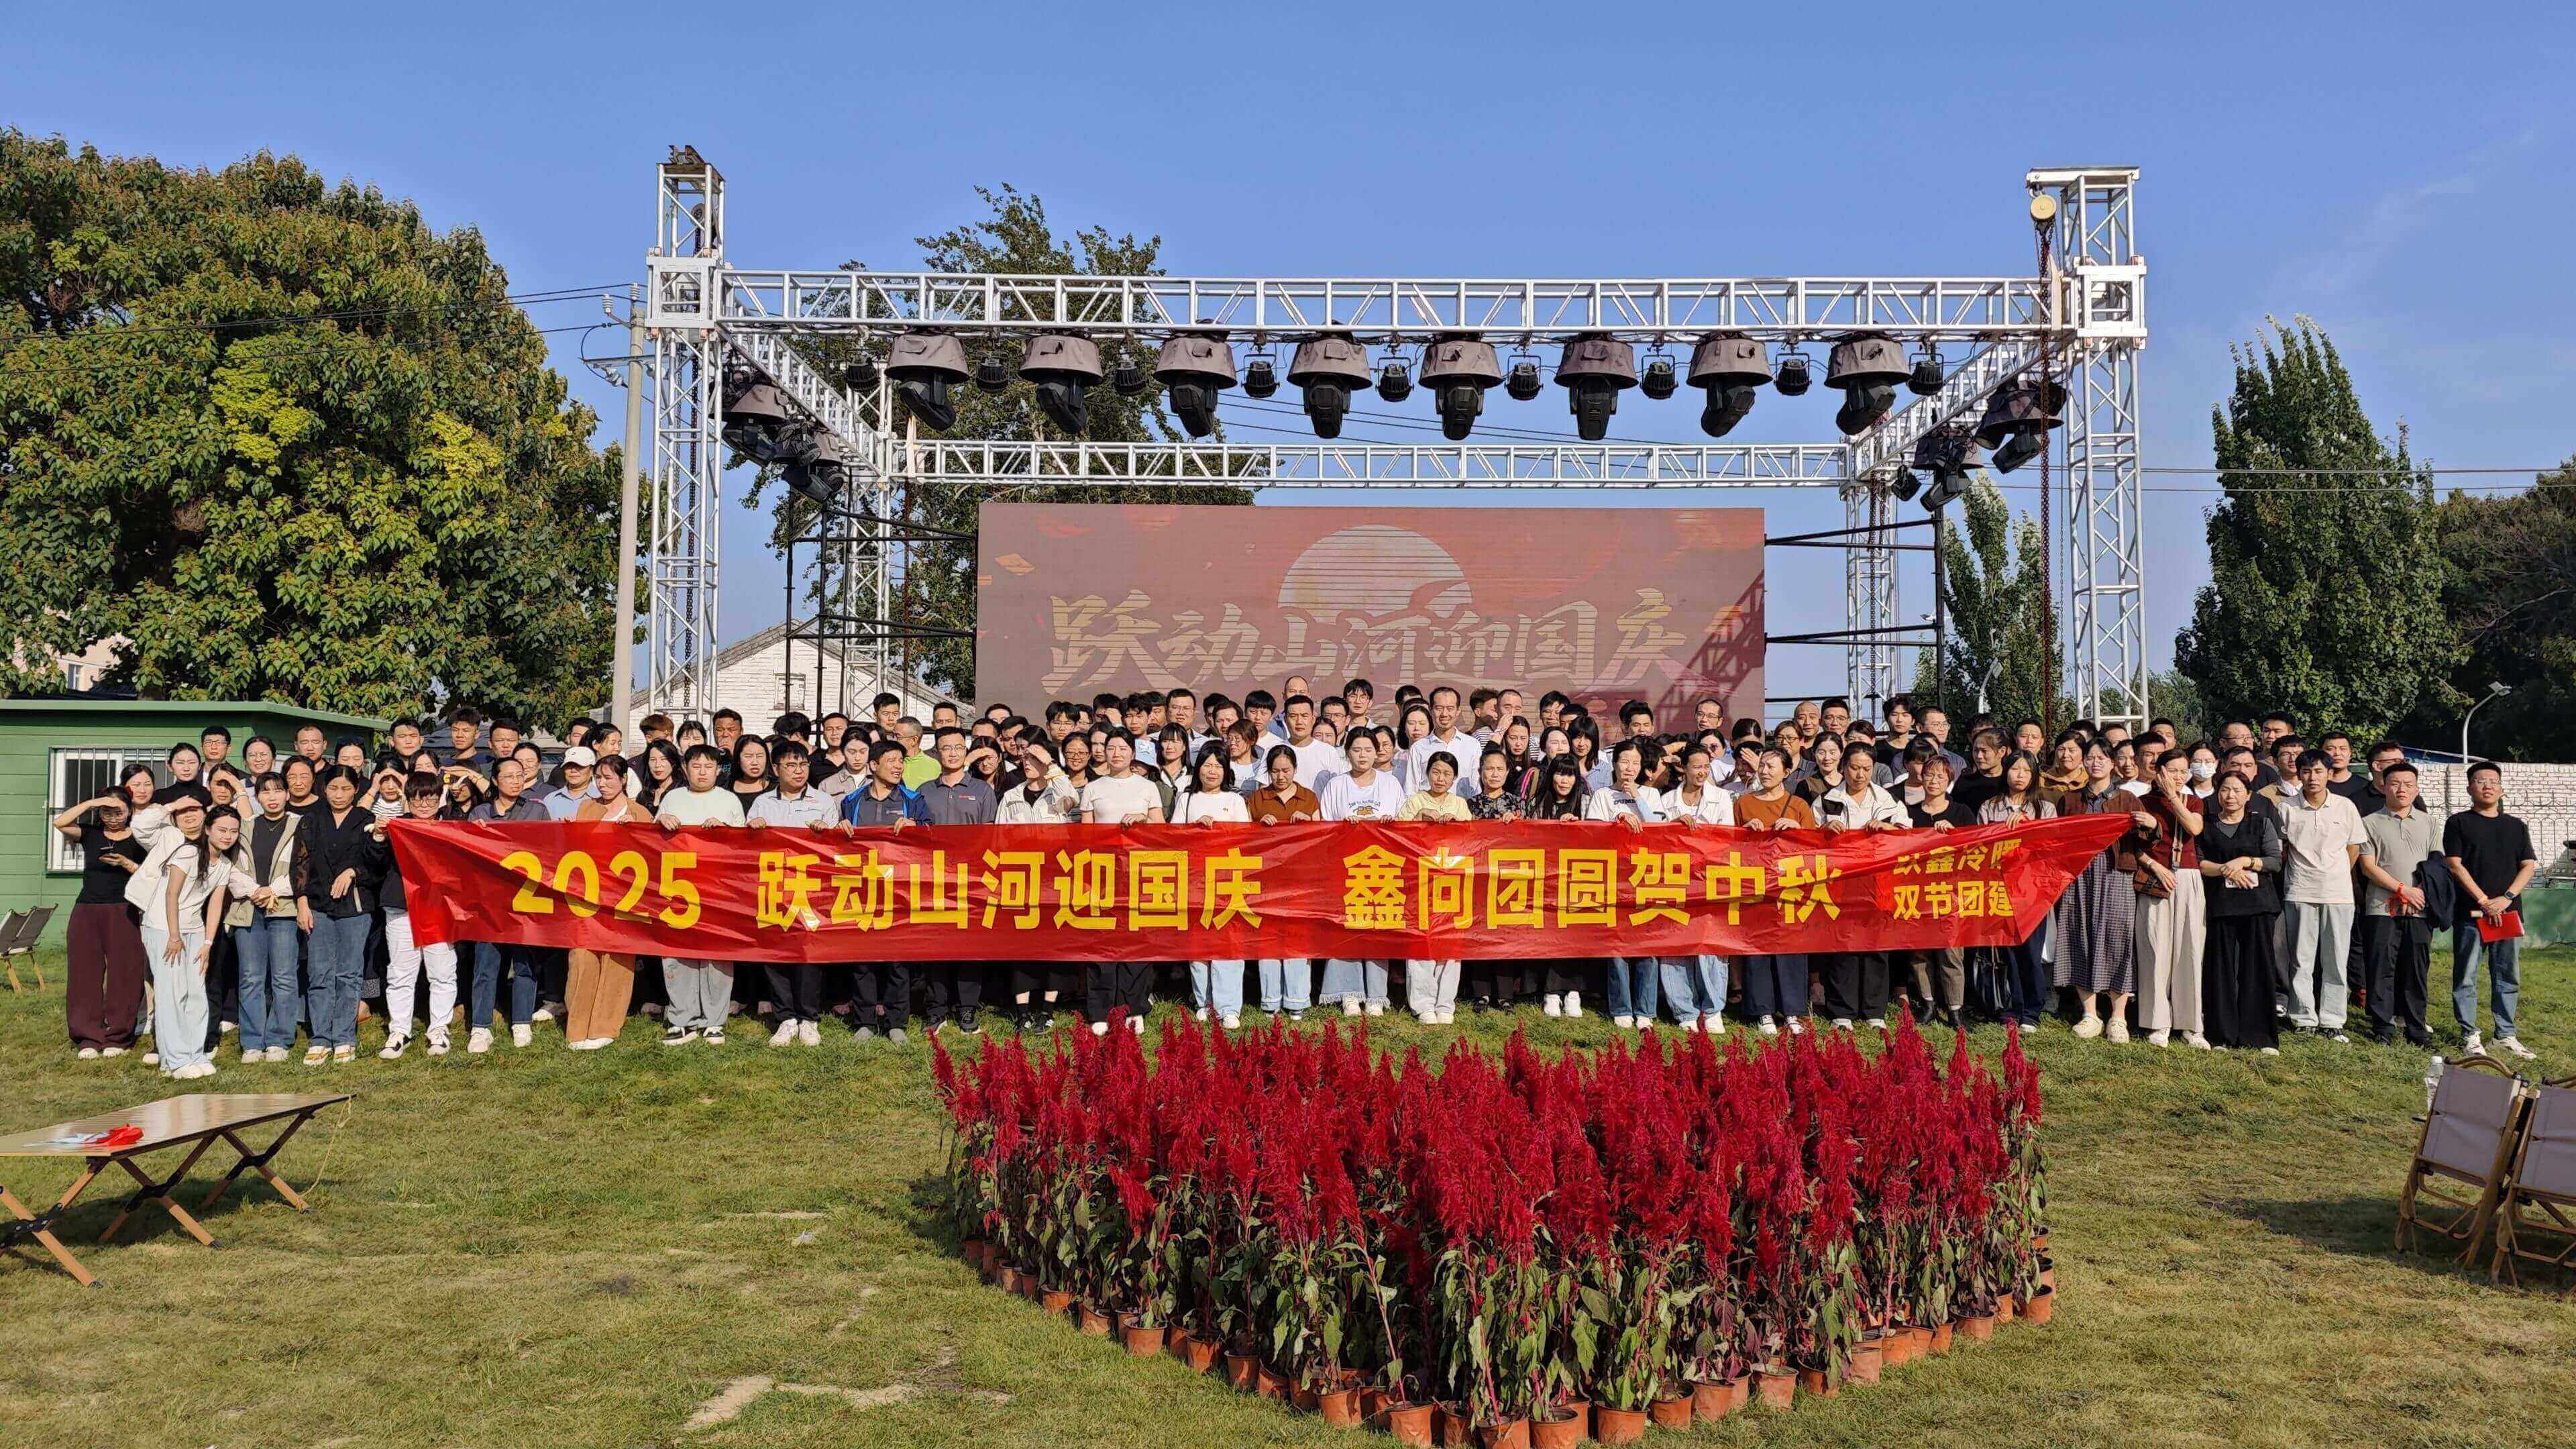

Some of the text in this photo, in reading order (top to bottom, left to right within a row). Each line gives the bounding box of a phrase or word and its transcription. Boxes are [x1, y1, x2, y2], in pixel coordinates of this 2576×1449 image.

[1041, 588, 1737, 696] 跃动山河迎国庆
[500, 844, 1843, 932] 2025 跃动山河迎国庆 鑫向团圆贺中秋
[1893, 881, 2015, 921] 双节团建
